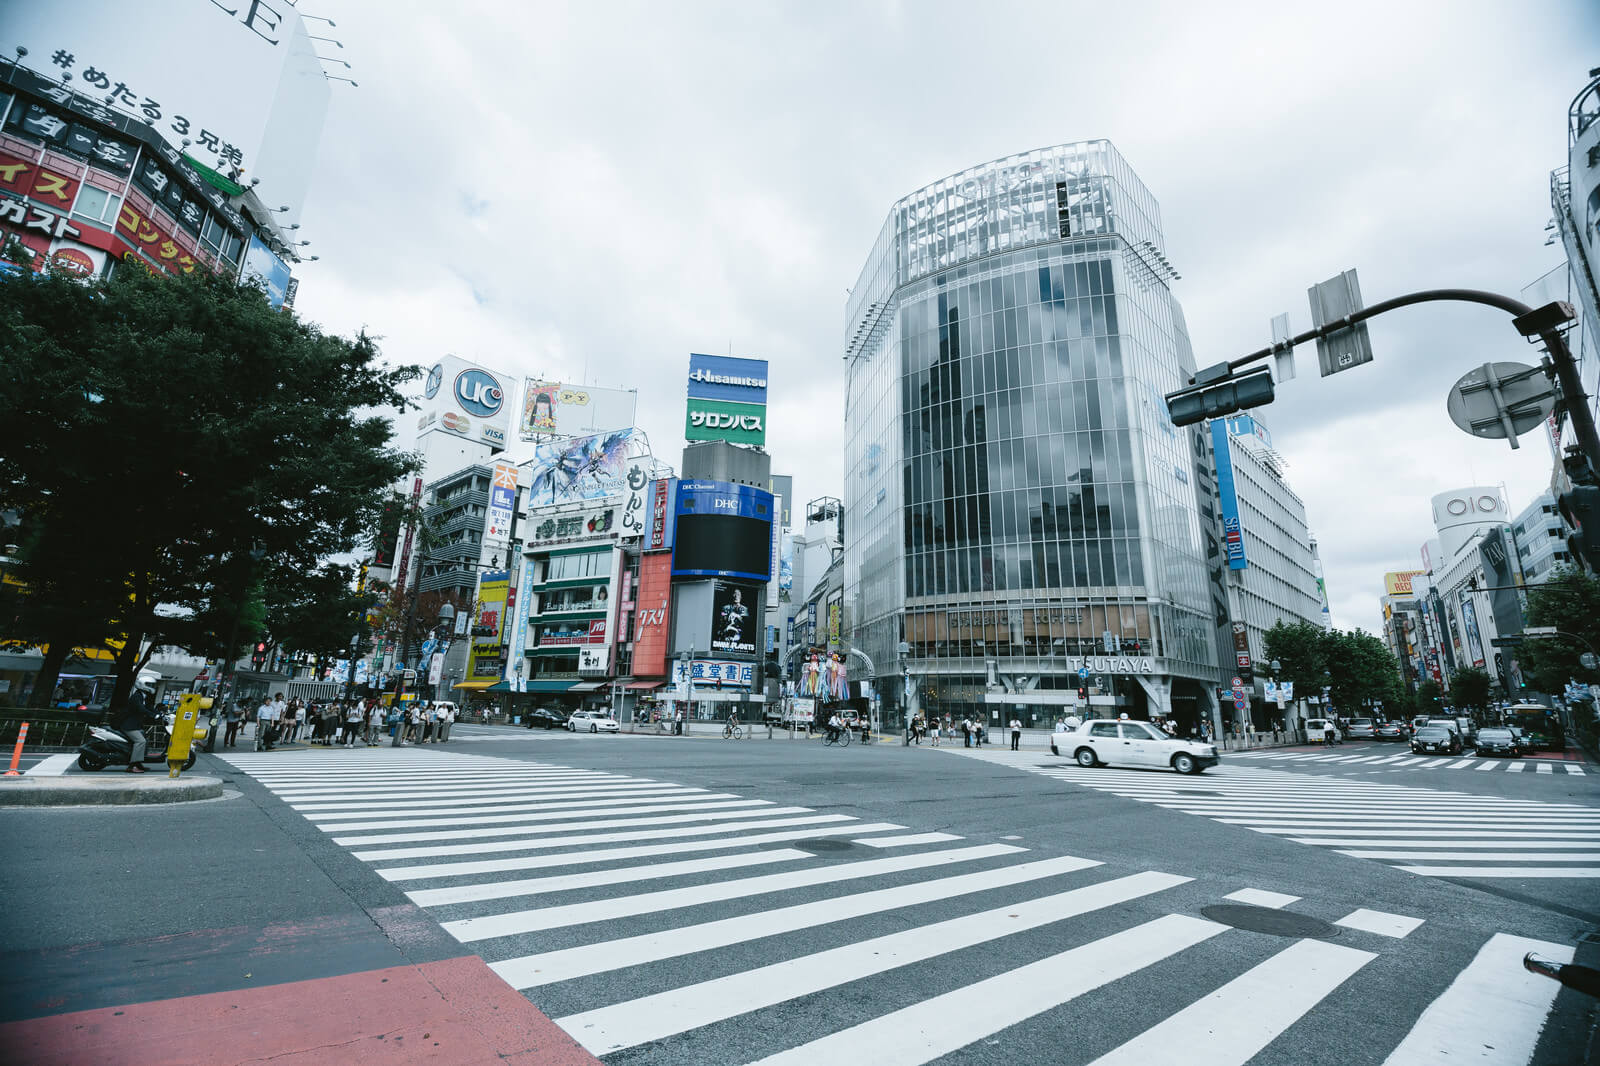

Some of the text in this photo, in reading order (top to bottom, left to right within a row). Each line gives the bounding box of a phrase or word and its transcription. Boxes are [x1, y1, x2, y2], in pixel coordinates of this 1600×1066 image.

[689, 368, 767, 389] Hisamitsu
[689, 410, 763, 432] サロンパス
[484, 428, 505, 441] VISA
[621, 463, 648, 534] もんじゃ
[714, 498, 739, 509] DHC
[1191, 422, 1229, 629] SUTAYA
[1224, 517, 1244, 560] SEIBU
[676, 664, 753, 681] 大盛堂書店
[1069, 657, 1153, 673] TSUTAYA
